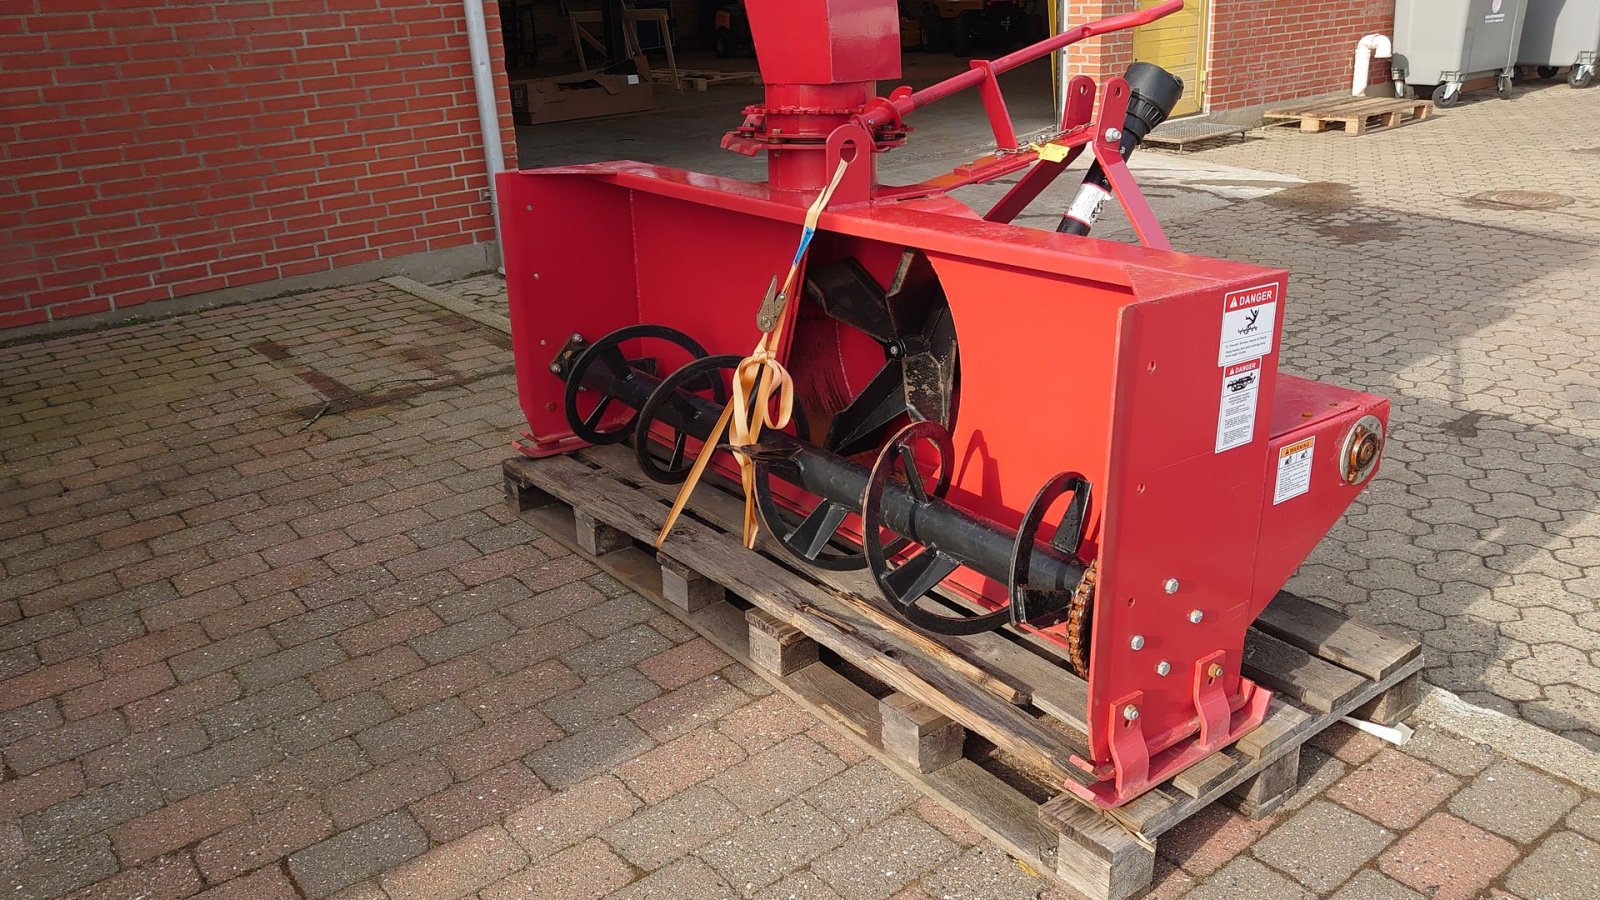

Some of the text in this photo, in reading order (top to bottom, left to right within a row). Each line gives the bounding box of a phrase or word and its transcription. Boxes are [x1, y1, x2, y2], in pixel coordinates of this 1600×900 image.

[1239, 290, 1272, 306] DANGER
[1234, 362, 1256, 374] DANGER
[1290, 441, 1310, 453] WARNING
